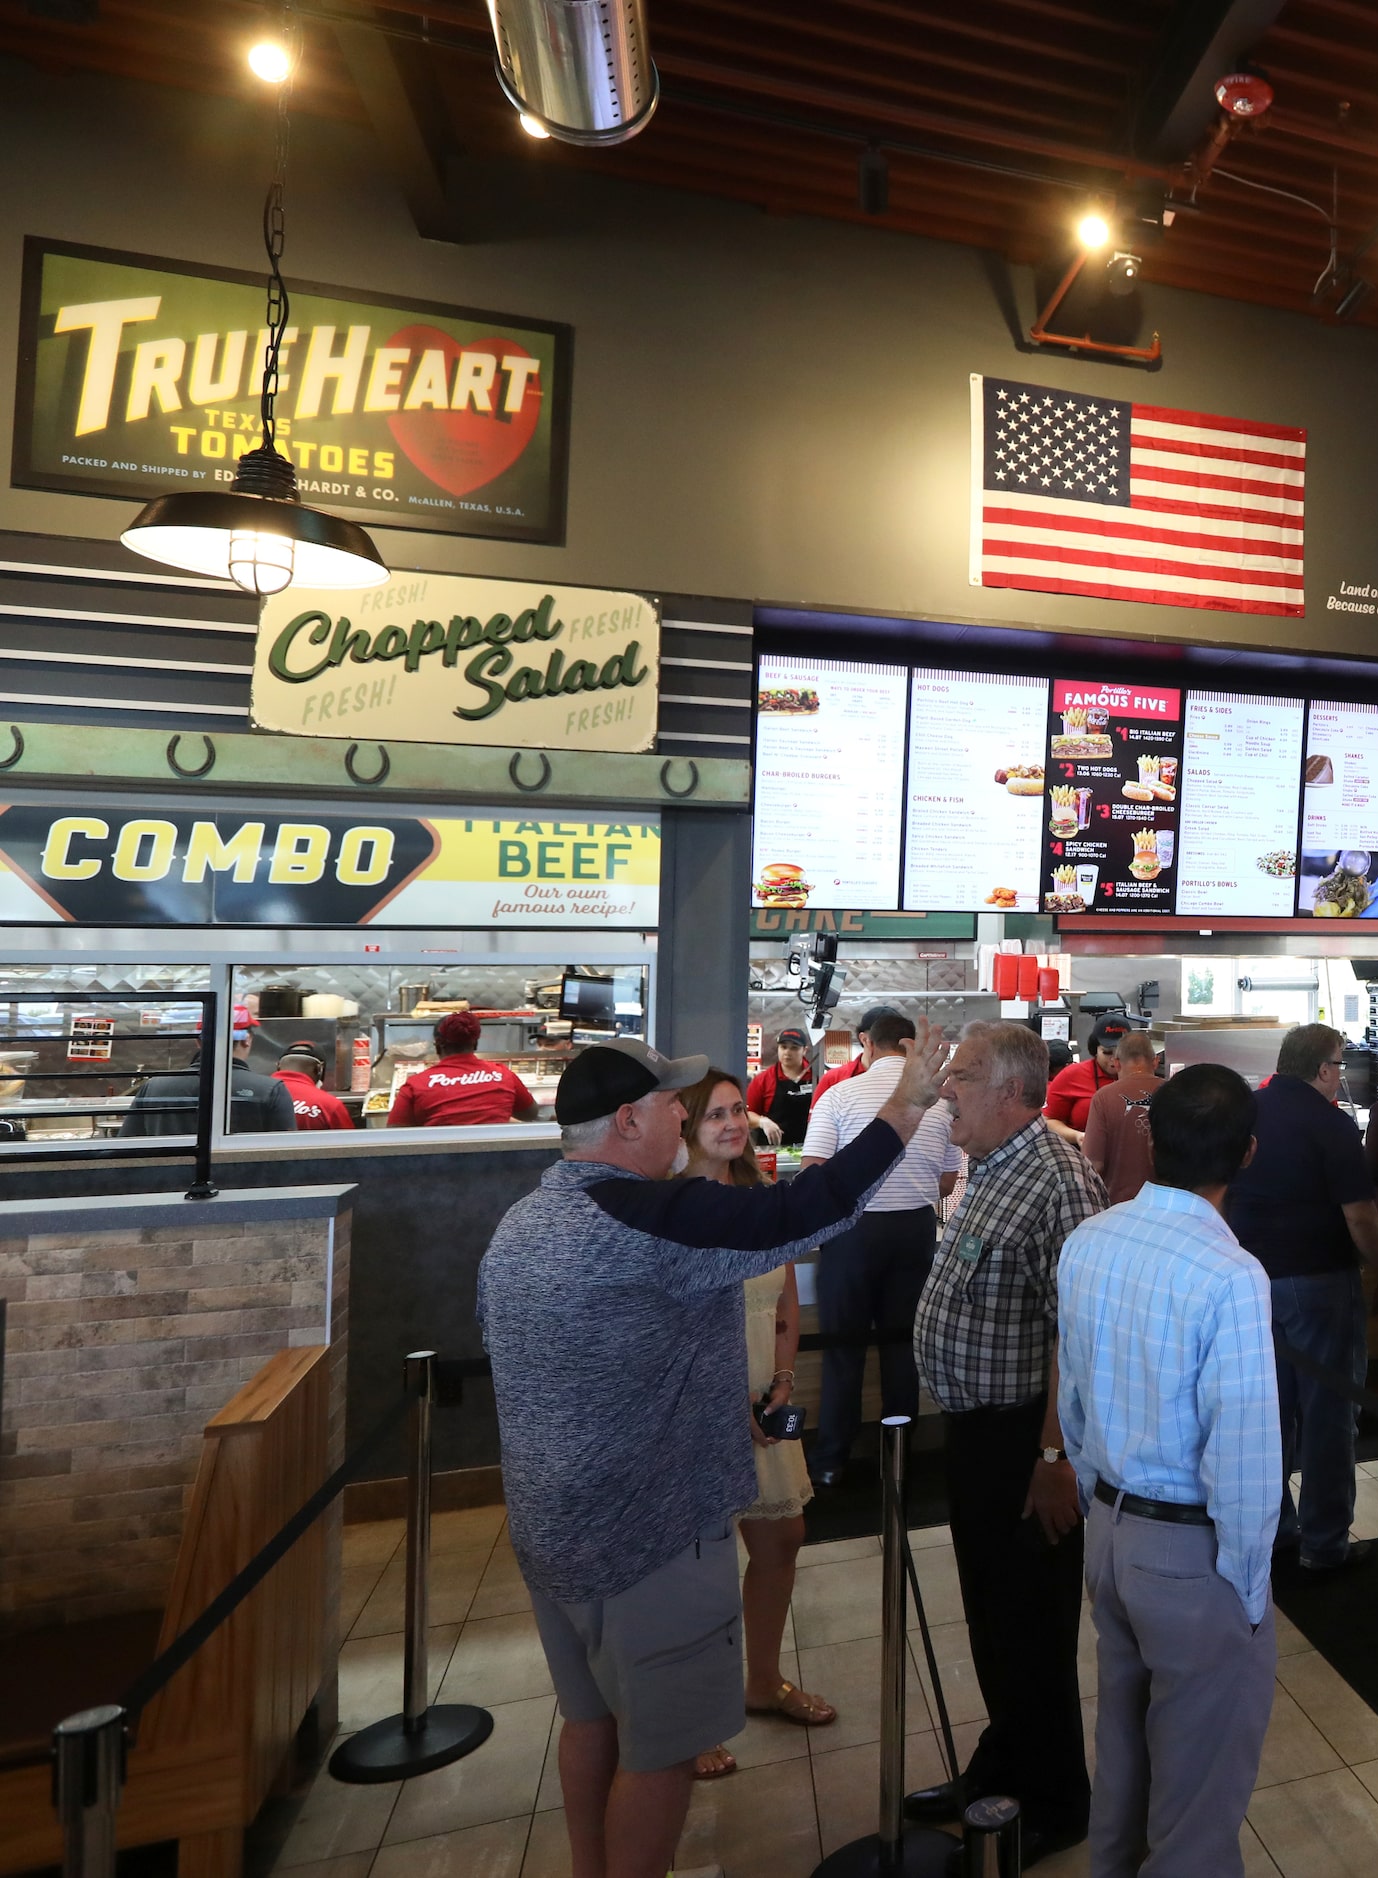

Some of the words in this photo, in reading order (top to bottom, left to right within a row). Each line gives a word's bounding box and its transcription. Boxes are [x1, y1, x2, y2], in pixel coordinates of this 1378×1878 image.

[204, 408, 291, 436] TEXAS
[170, 426, 396, 479] TOMATOES
[62, 455, 108, 469] PACKED
[112, 461, 138, 472] AND
[141, 464, 190, 478] SHIPPED
[193, 470, 206, 480] BY
[355, 486, 368, 498] &
[372, 488, 400, 502] CO.
[408, 496, 456, 510] McALLEN,
[495, 506, 525, 517] U.S.A.
[360, 580, 428, 614] FRESH!
[1340, 581, 1370, 598] Land
[1327, 596, 1376, 615] Because
[569, 604, 642, 643] FRESH!
[268, 594, 565, 684] Chopped
[453, 641, 649, 721] Salad
[790, 674, 819, 682] SAUSAGE
[1101, 685, 1132, 696] Portillo's
[302, 675, 397, 727] FRESH!
[1065, 693, 1128, 708] FAMOUS
[1134, 697, 1166, 712] FIVE
[1190, 704, 1208, 713] FRIES
[1216, 706, 1232, 714] SIDES
[565, 696, 634, 735] FRESH!
[811, 772, 841, 780] BURGERS
[913, 795, 942, 803] CHICKEN
[41, 817, 395, 887] COMBO
[499, 840, 632, 880] BEEF
[524, 884, 563, 899] Our
[566, 889, 608, 900] own
[1182, 880, 1216, 888] PORTILLO'S
[492, 900, 566, 918] famous
[570, 901, 636, 918] recipe!
[428, 1071, 503, 1088] Portillo's
